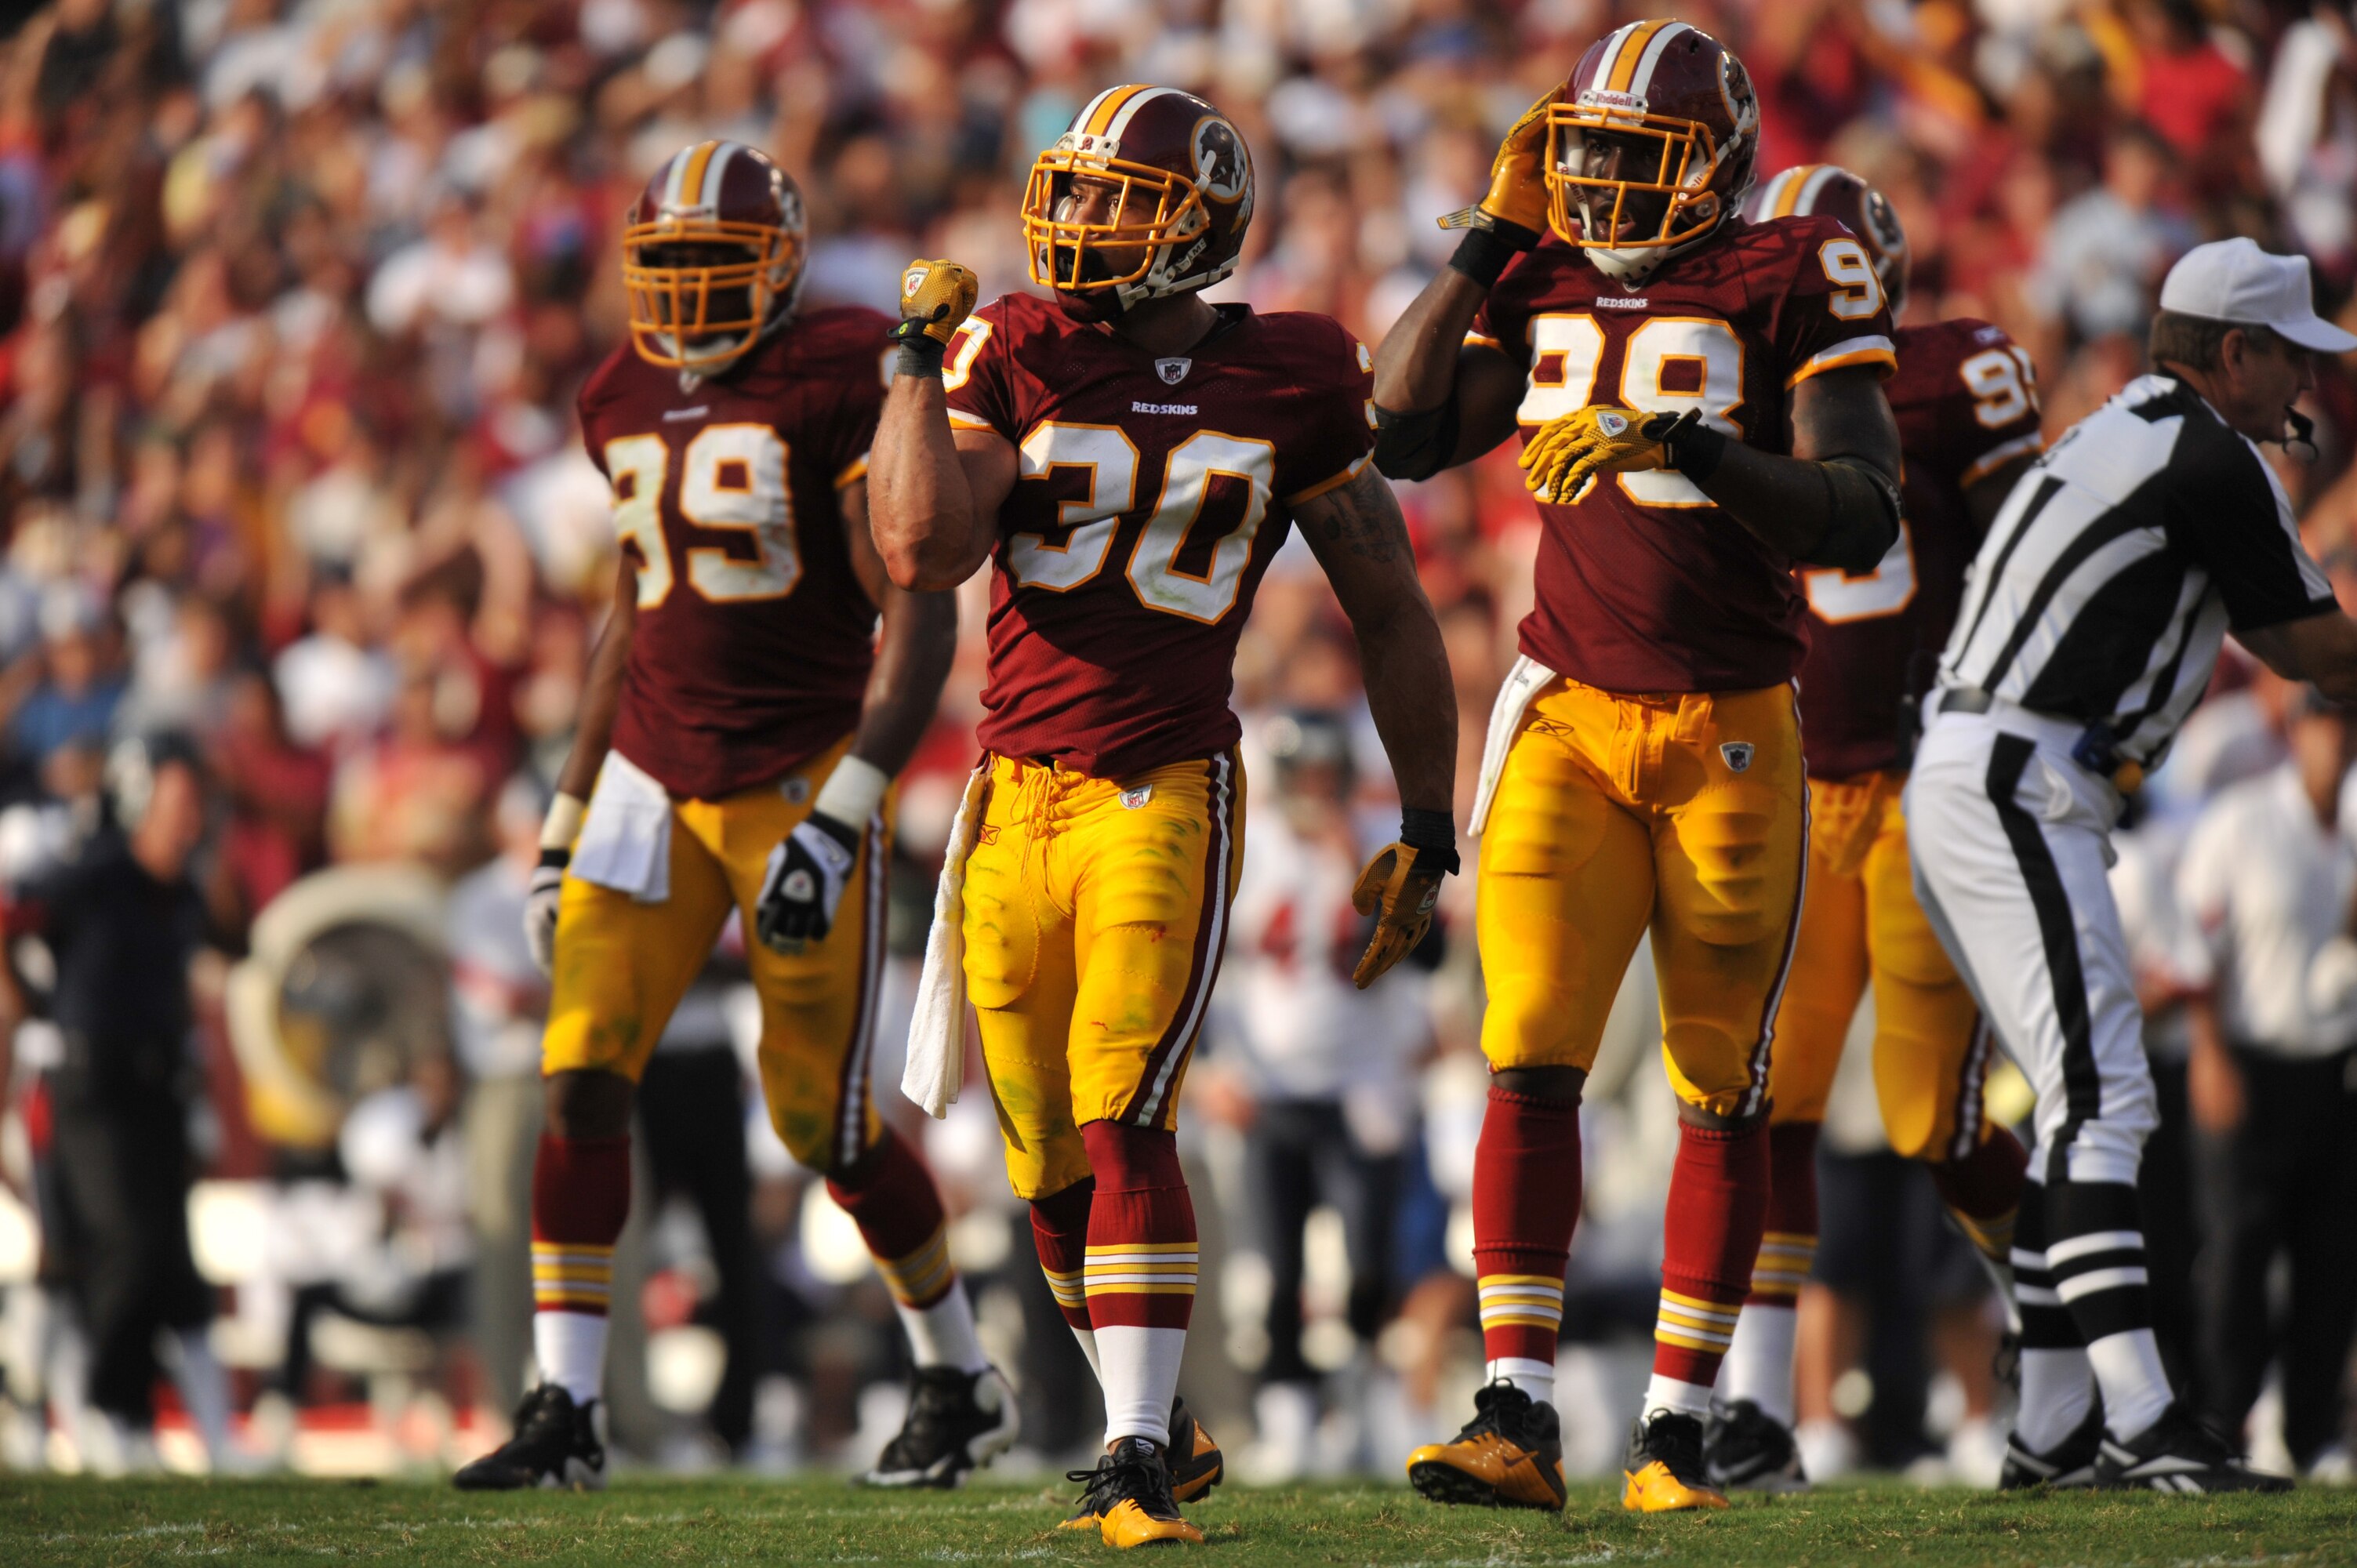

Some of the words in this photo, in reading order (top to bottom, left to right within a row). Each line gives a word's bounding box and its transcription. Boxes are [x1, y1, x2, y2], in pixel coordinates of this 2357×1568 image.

[1596, 93, 1632, 107] Riddell
[1596, 296, 1648, 309] REDSKINS
[1131, 401, 1198, 416] REDSKINS
[1009, 419, 1276, 626] 30
